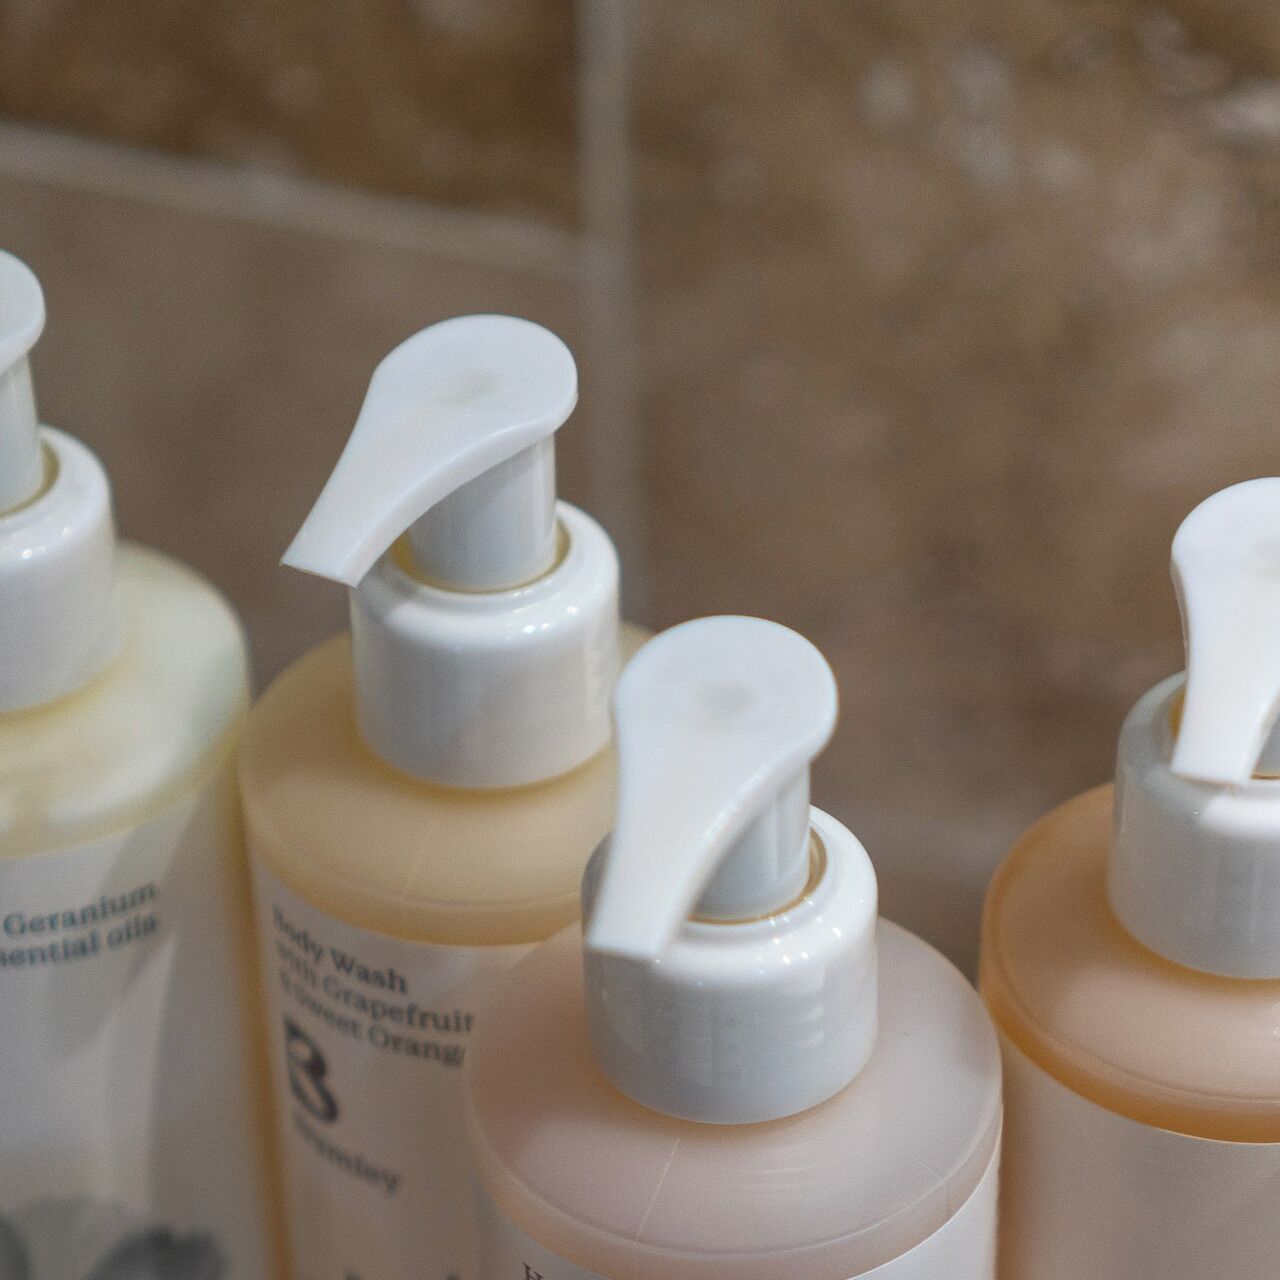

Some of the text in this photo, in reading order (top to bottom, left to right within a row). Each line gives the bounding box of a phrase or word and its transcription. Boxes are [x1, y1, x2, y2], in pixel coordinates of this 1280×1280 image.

[3, 880, 158, 940] Geranium
[107, 915, 158, 952] oils
[328, 946, 409, 995] Wash
